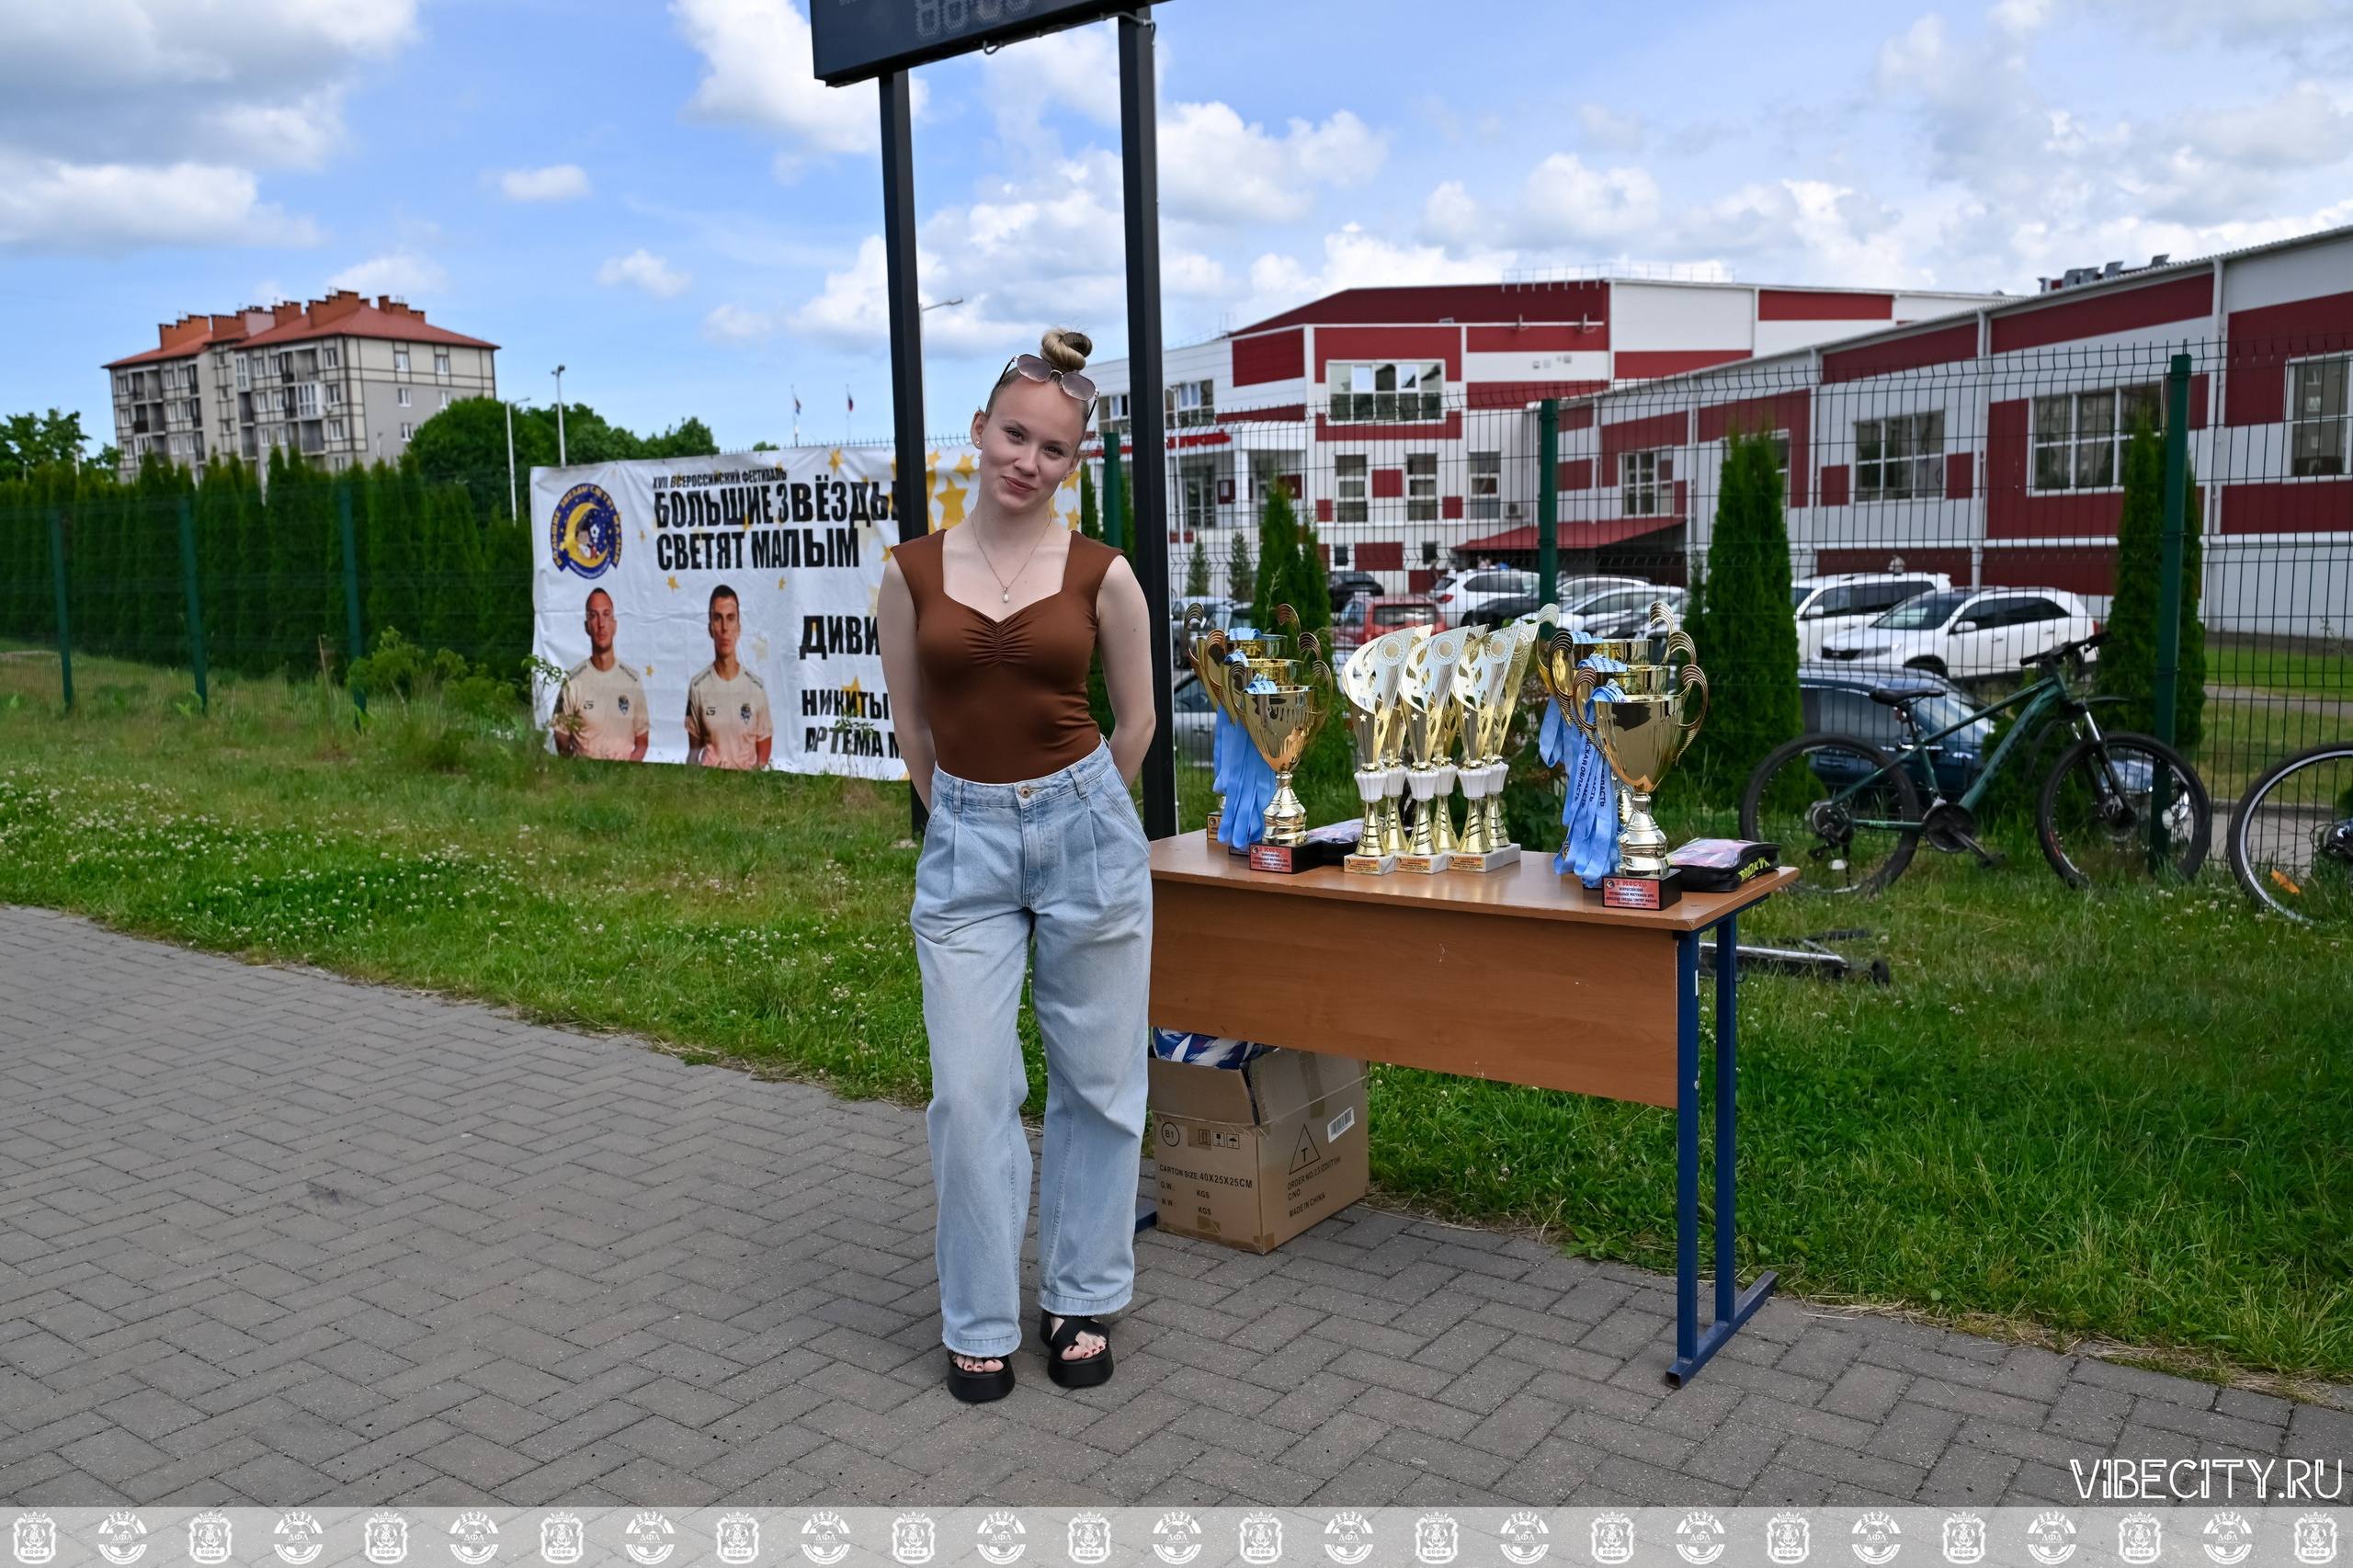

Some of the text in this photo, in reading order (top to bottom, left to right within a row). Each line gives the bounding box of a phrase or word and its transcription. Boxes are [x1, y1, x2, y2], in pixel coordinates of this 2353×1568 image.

[653, 468, 787, 489] XVII ВСЕРОССИЙСКИЙ ФЕСТИВАЛЬ
[654, 485, 774, 528] БОЛЬШИЕ
[656, 531, 745, 571] СВЕТЯТ
[750, 528, 859, 569] МАЛЫМ
[801, 689, 890, 720] НИКИТЫ
[1165, 1130, 1174, 1139] B1
[1301, 1147, 1308, 1162] T
[1159, 1165, 1183, 1176] CARTON
[1287, 1175, 1305, 1190] ORDER
[1197, 1189, 1210, 1199] KGS
[1198, 1206, 1211, 1216] KGS
[1289, 1192, 1325, 1218] MADE IN CHINA
